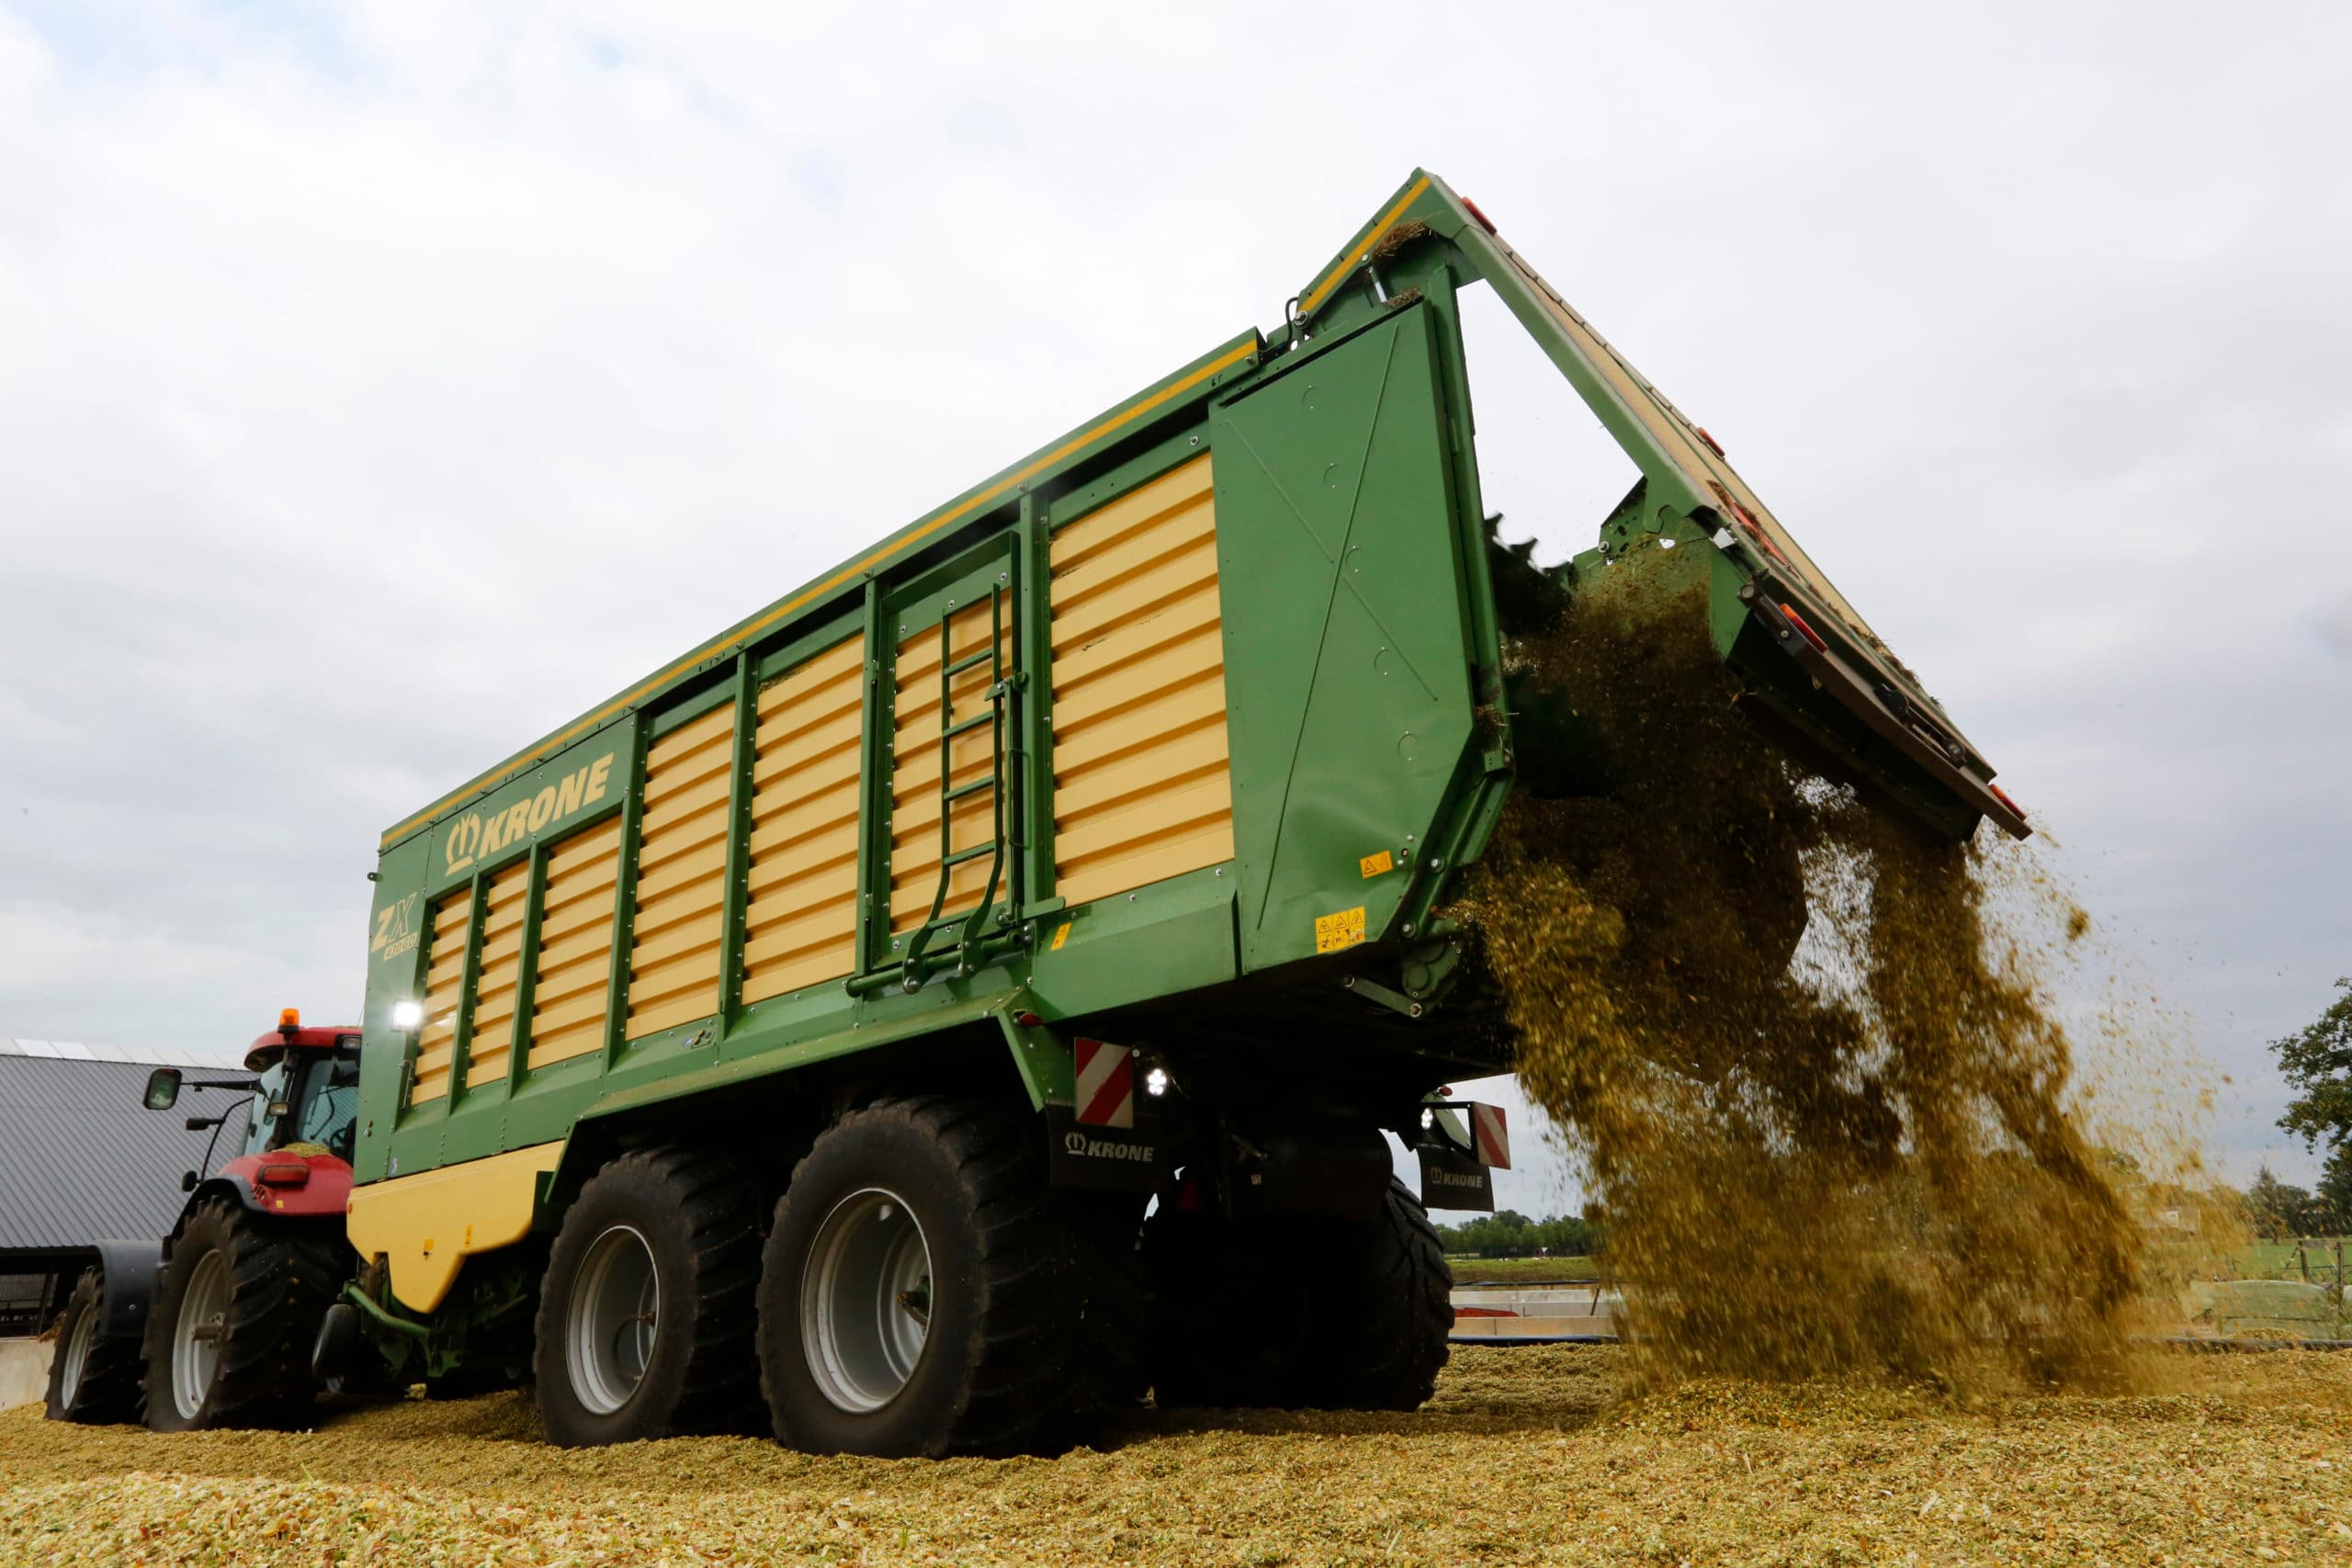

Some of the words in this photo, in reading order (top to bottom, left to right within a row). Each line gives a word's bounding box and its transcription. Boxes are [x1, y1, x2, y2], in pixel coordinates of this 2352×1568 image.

[477, 752, 615, 860] KRONE
[370, 892, 418, 953] ZX
[1087, 1140, 1155, 1162] KRONE
[1442, 1172, 1484, 1189] KRONE
